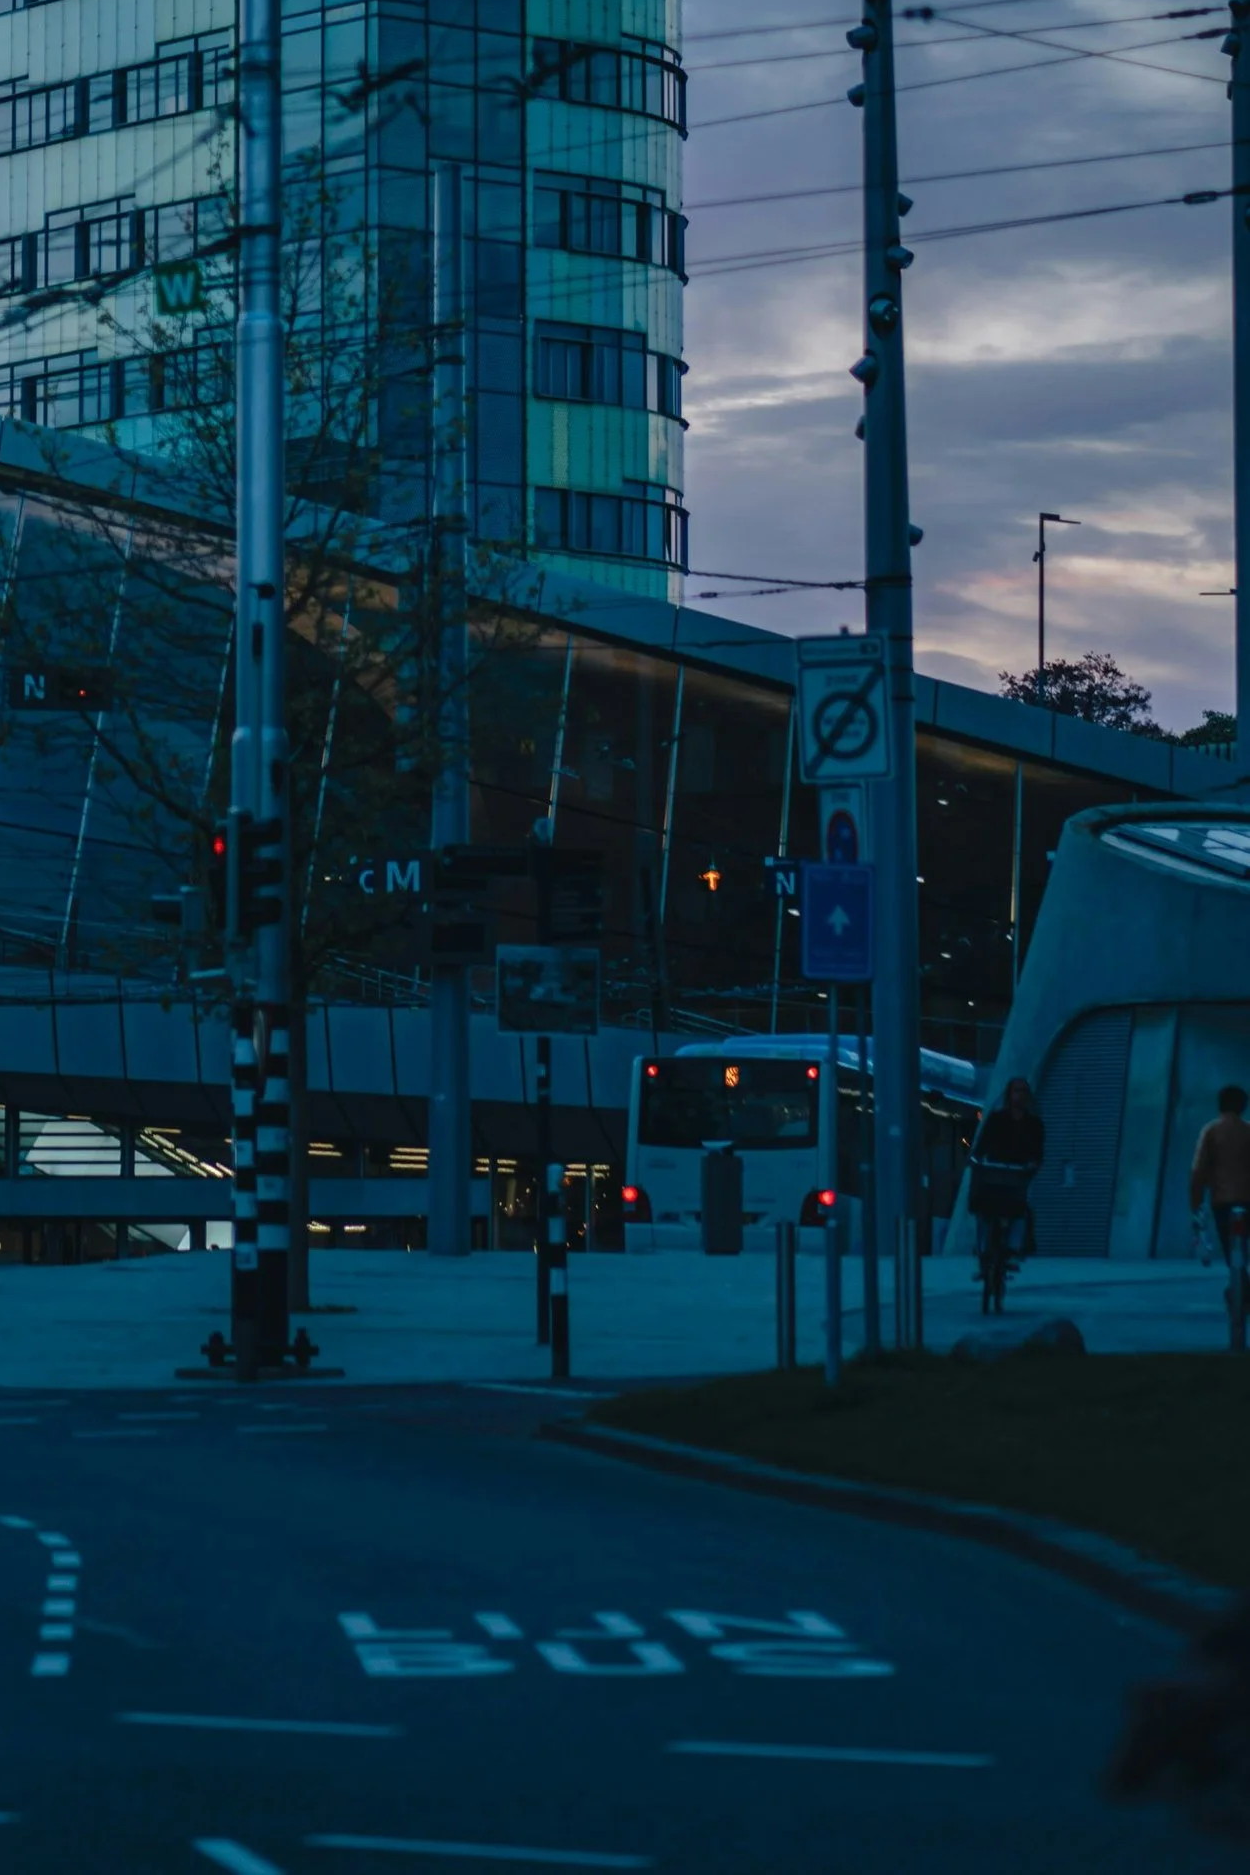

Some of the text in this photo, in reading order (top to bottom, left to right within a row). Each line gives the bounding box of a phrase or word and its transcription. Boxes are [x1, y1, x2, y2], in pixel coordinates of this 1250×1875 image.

[161, 271, 196, 307] W
[23, 673, 45, 702] N
[385, 859, 421, 894] M
[776, 870, 796, 895] N
